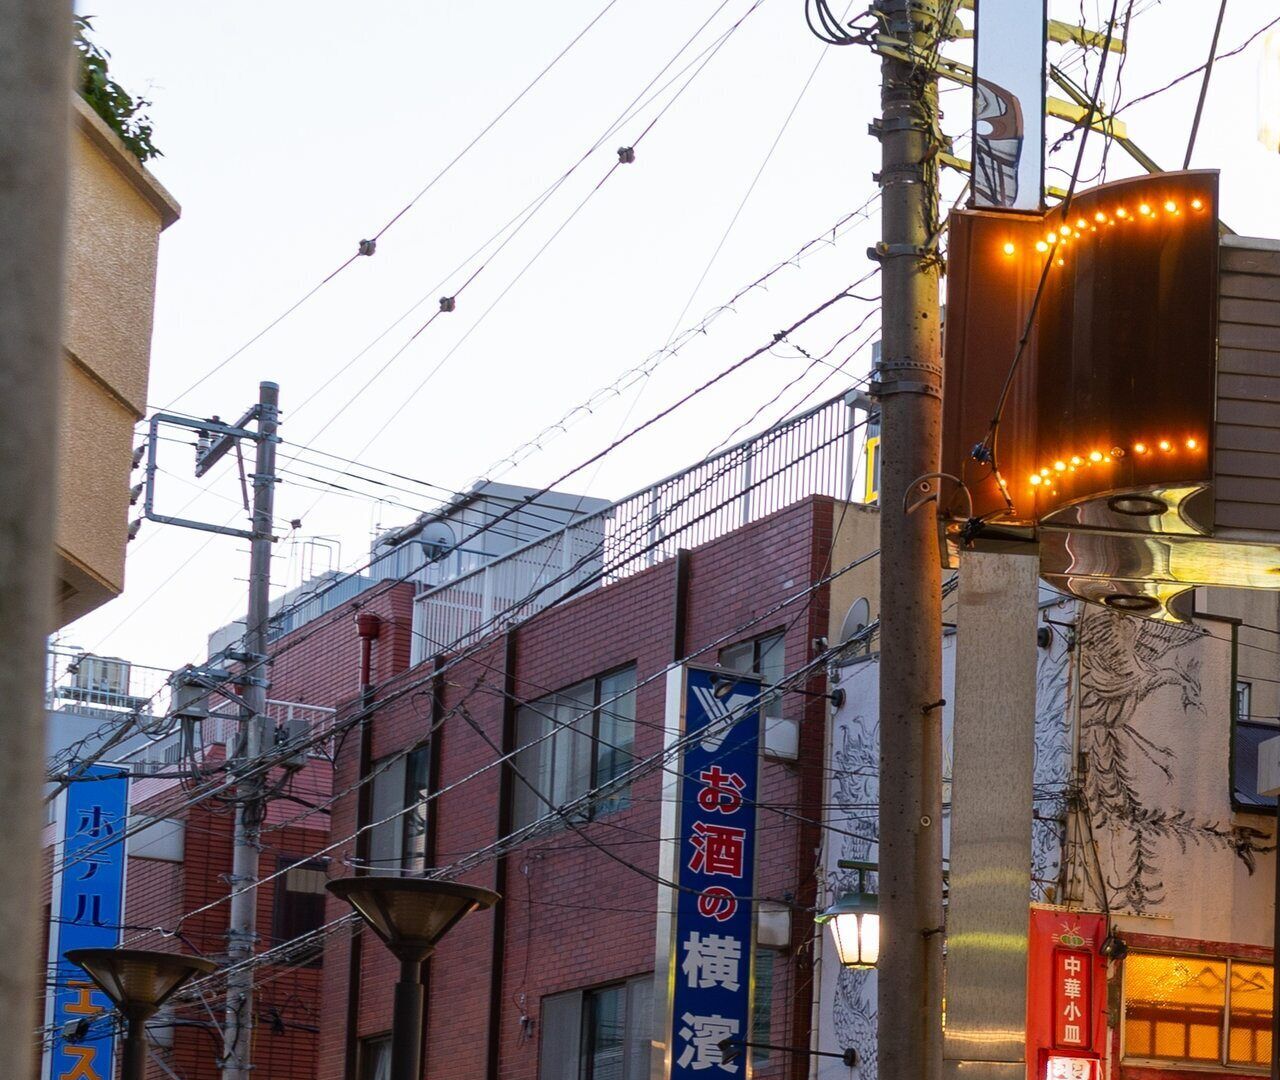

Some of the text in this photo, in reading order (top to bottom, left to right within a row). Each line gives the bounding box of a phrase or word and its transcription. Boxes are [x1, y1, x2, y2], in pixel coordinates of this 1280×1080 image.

[73, 805, 114, 928] ホテル
[1063, 956, 1082, 1044] 中華小皿
